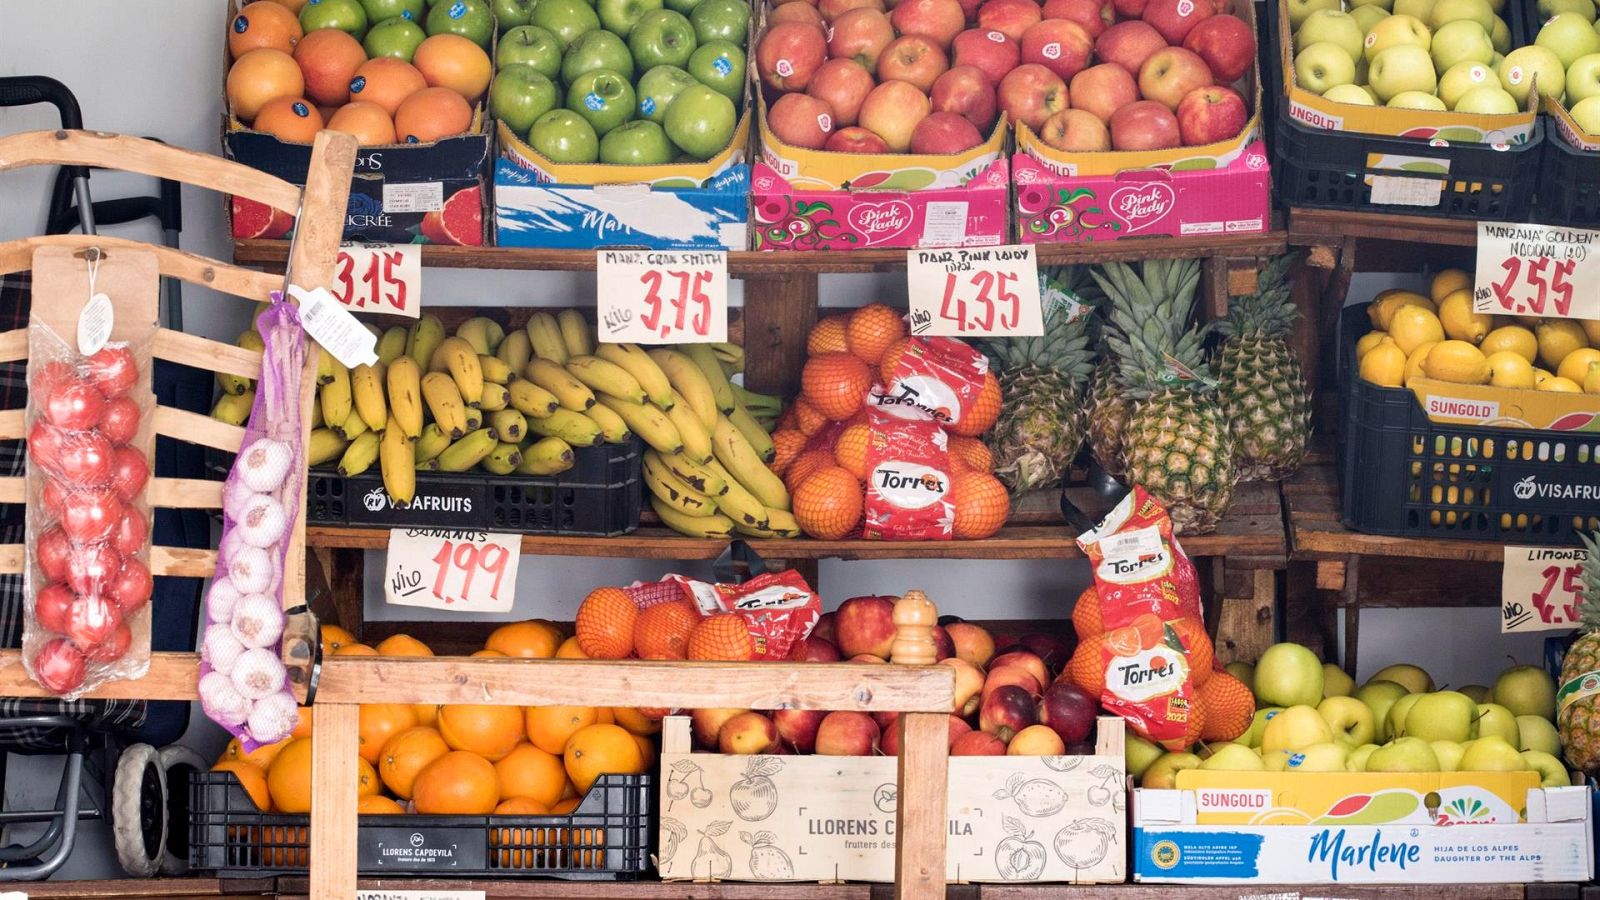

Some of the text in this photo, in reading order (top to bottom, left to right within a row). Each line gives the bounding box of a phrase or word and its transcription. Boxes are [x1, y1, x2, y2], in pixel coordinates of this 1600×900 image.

[1289, 104, 1335, 130] UNGOLD
[1119, 187, 1163, 211] Pink
[859, 204, 901, 226] Pink
[1126, 199, 1166, 220] Lady
[865, 215, 904, 234] Lady
[681, 253, 722, 266] SMITH
[958, 250, 991, 261] PINK
[331, 251, 407, 311] 3.15
[1491, 255, 1577, 317] 2.55
[940, 270, 1020, 332] 4.35
[1430, 400, 1491, 418] SUNGOLD
[877, 468, 944, 494] Torres
[1537, 483, 1600, 501] VISAFRU
[387, 495, 472, 513] VAFRUITS
[1107, 552, 1164, 575] Torres
[1527, 550, 1589, 561] LIMONES
[1117, 662, 1175, 686] Torres
[1166, 712, 1187, 722] 2023
[1201, 793, 1265, 808] SUNGOLD
[808, 819, 878, 836] LLORENS
[382, 848, 453, 857] LLORENS CAPDEVILA
[844, 840, 878, 849] fruiters
[1308, 828, 1420, 881] Marlene
